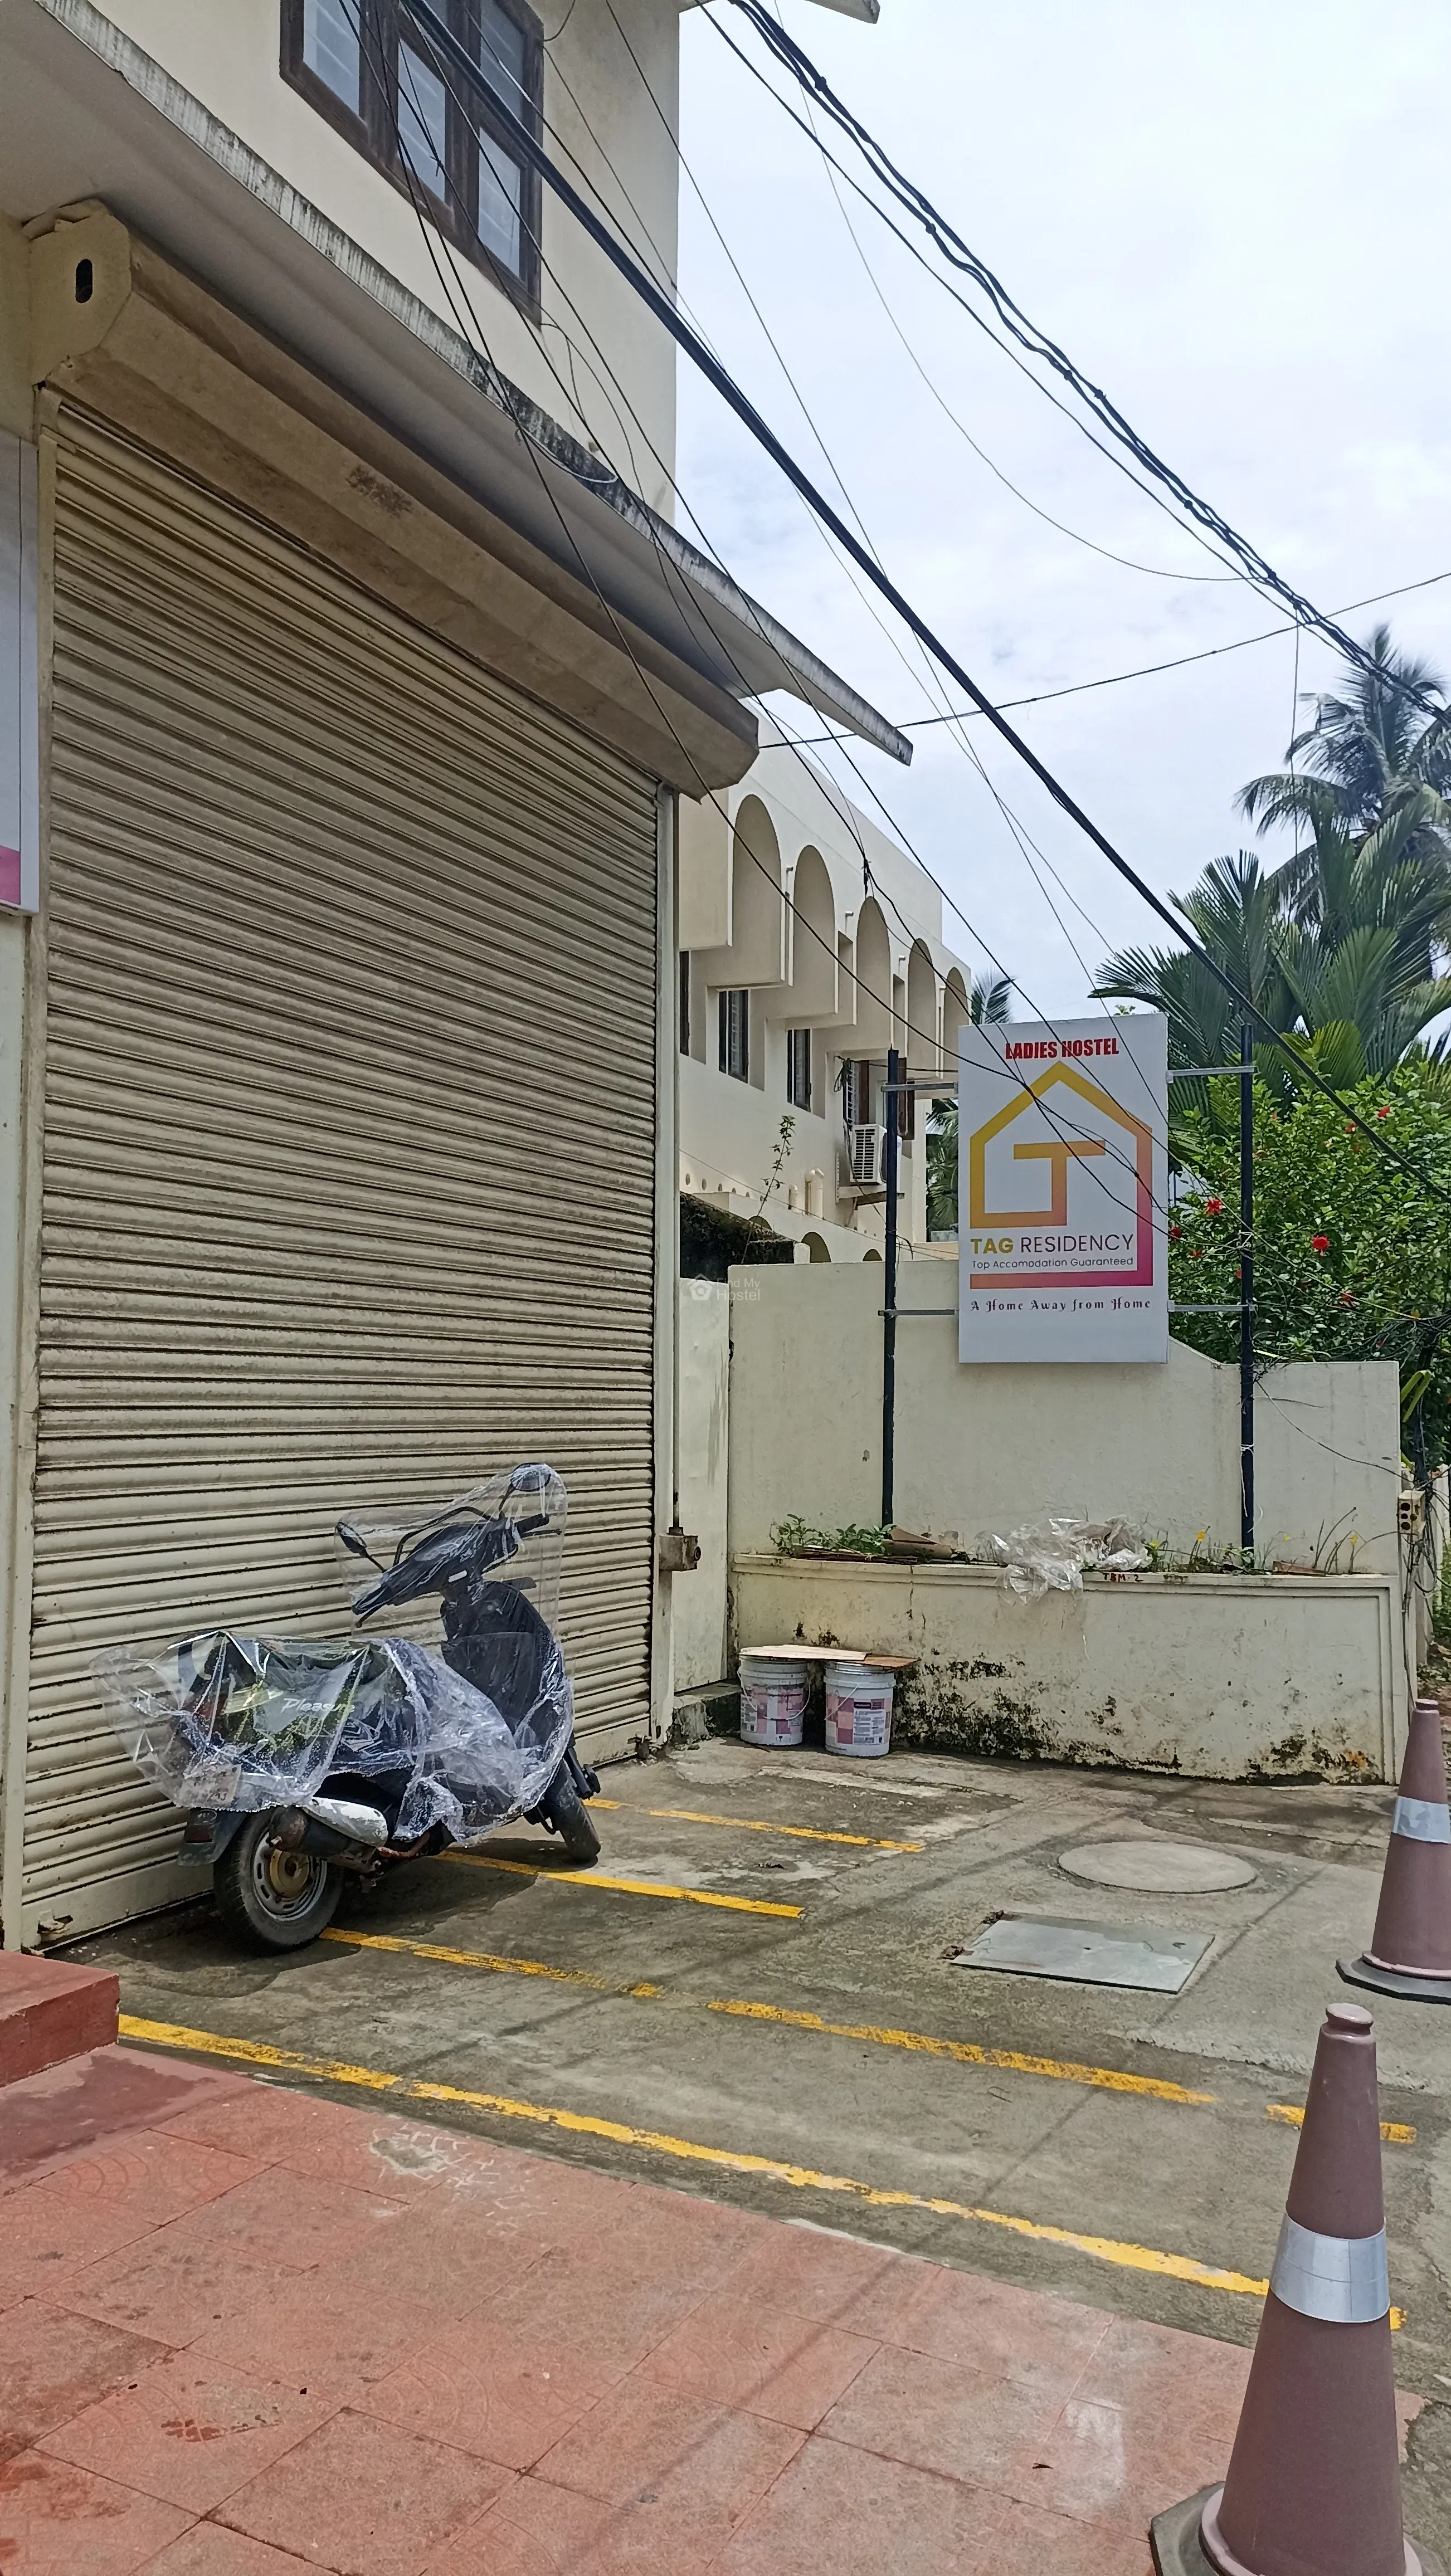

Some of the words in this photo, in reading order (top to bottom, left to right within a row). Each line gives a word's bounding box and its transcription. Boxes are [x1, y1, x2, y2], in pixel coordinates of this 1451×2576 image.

[1005, 1042, 1057, 1059] LADIES
[1062, 1038, 1119, 1057] HOSTEL
[970, 1237, 1014, 1254] TAG
[1021, 1234, 1133, 1253] RESIDENCY
[972, 1260, 990, 1270] Top
[993, 1258, 1067, 1269] Accomodation
[1070, 1257, 1133, 1266] Guaranteed
[970, 1301, 980, 1311] A
[986, 1299, 1023, 1313] Home
[1031, 1300, 1066, 1312] Away
[1071, 1299, 1104, 1312] from
[1111, 1296, 1151, 1311] Home
